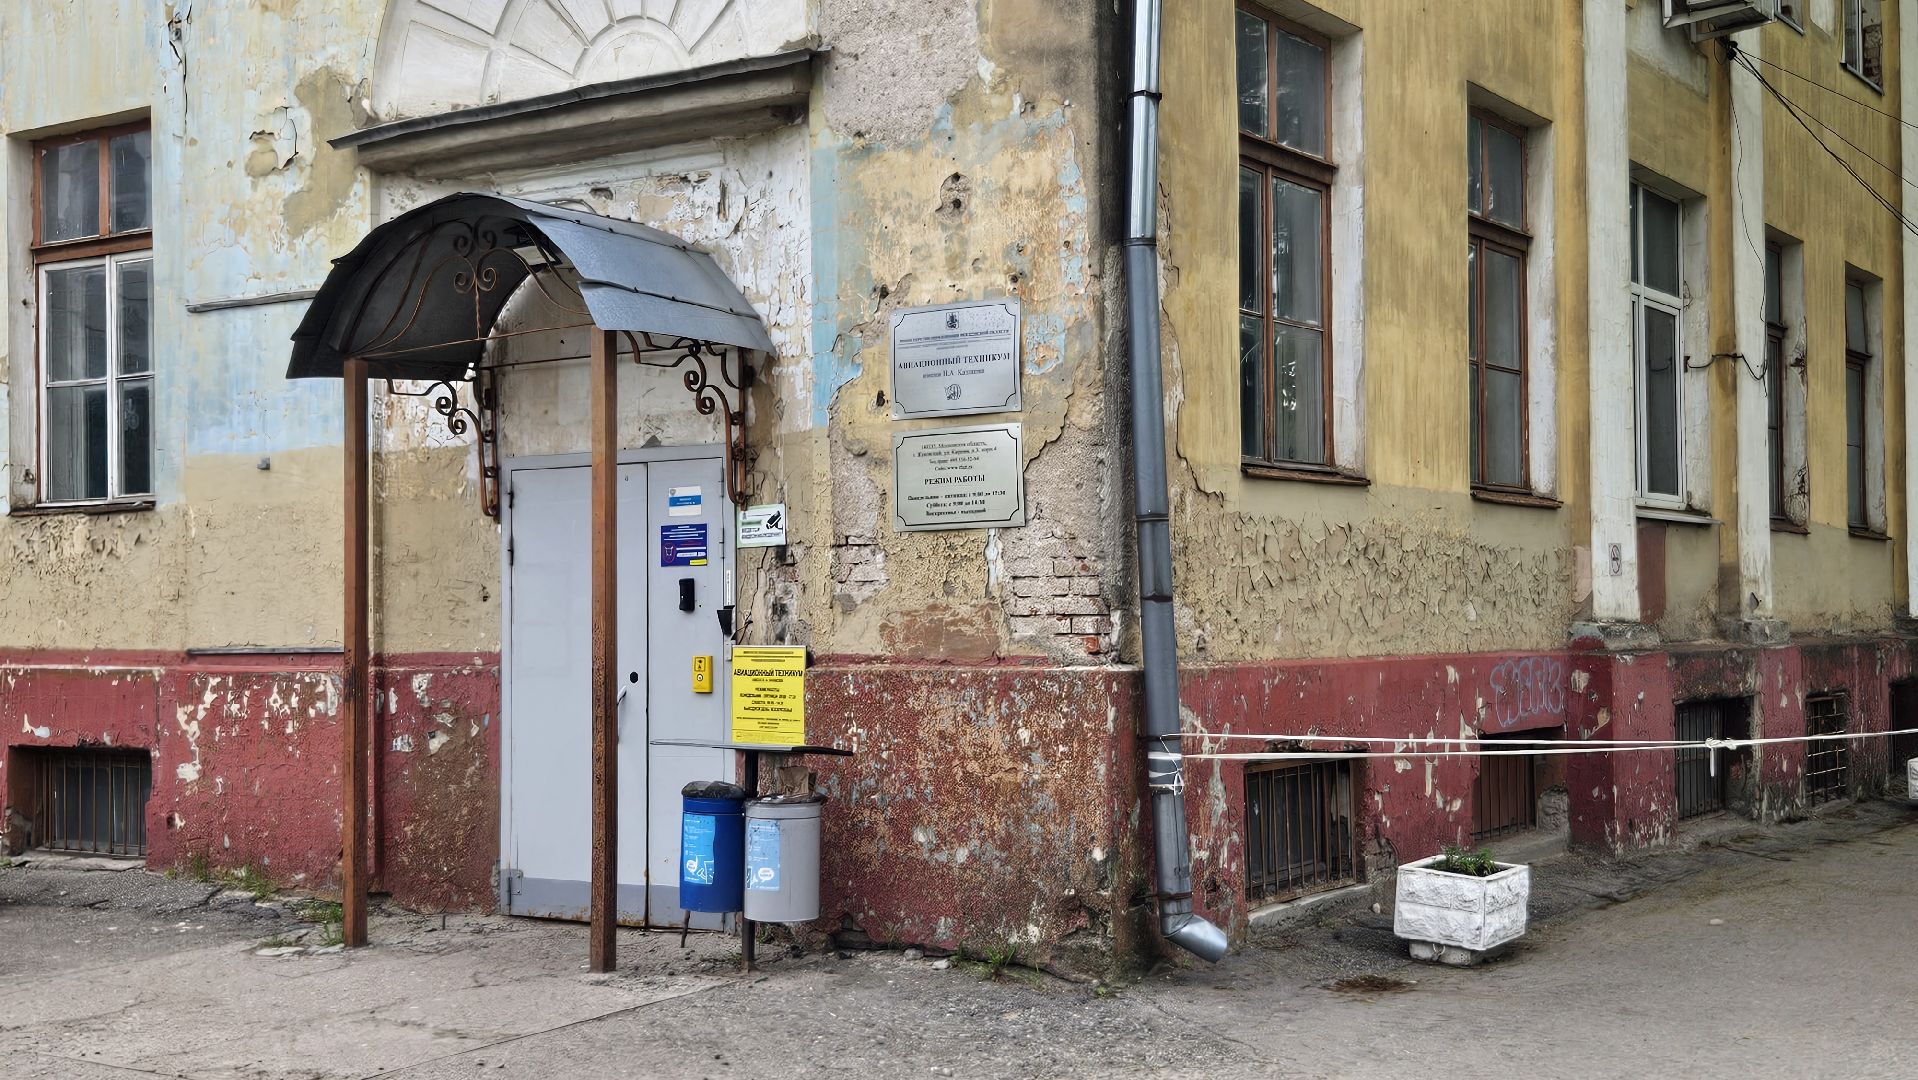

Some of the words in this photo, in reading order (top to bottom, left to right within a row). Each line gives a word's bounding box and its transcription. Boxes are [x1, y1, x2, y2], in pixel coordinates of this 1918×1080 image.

[898, 356, 961, 370] АВИАЦИОННЫЙ
[963, 352, 1010, 364] ТЕХНИКУМ
[924, 477, 952, 485] РЕЖИМ
[954, 474, 985, 484] РАБОТЫ
[734, 668, 774, 676] АВИАЦИОННЫЙ
